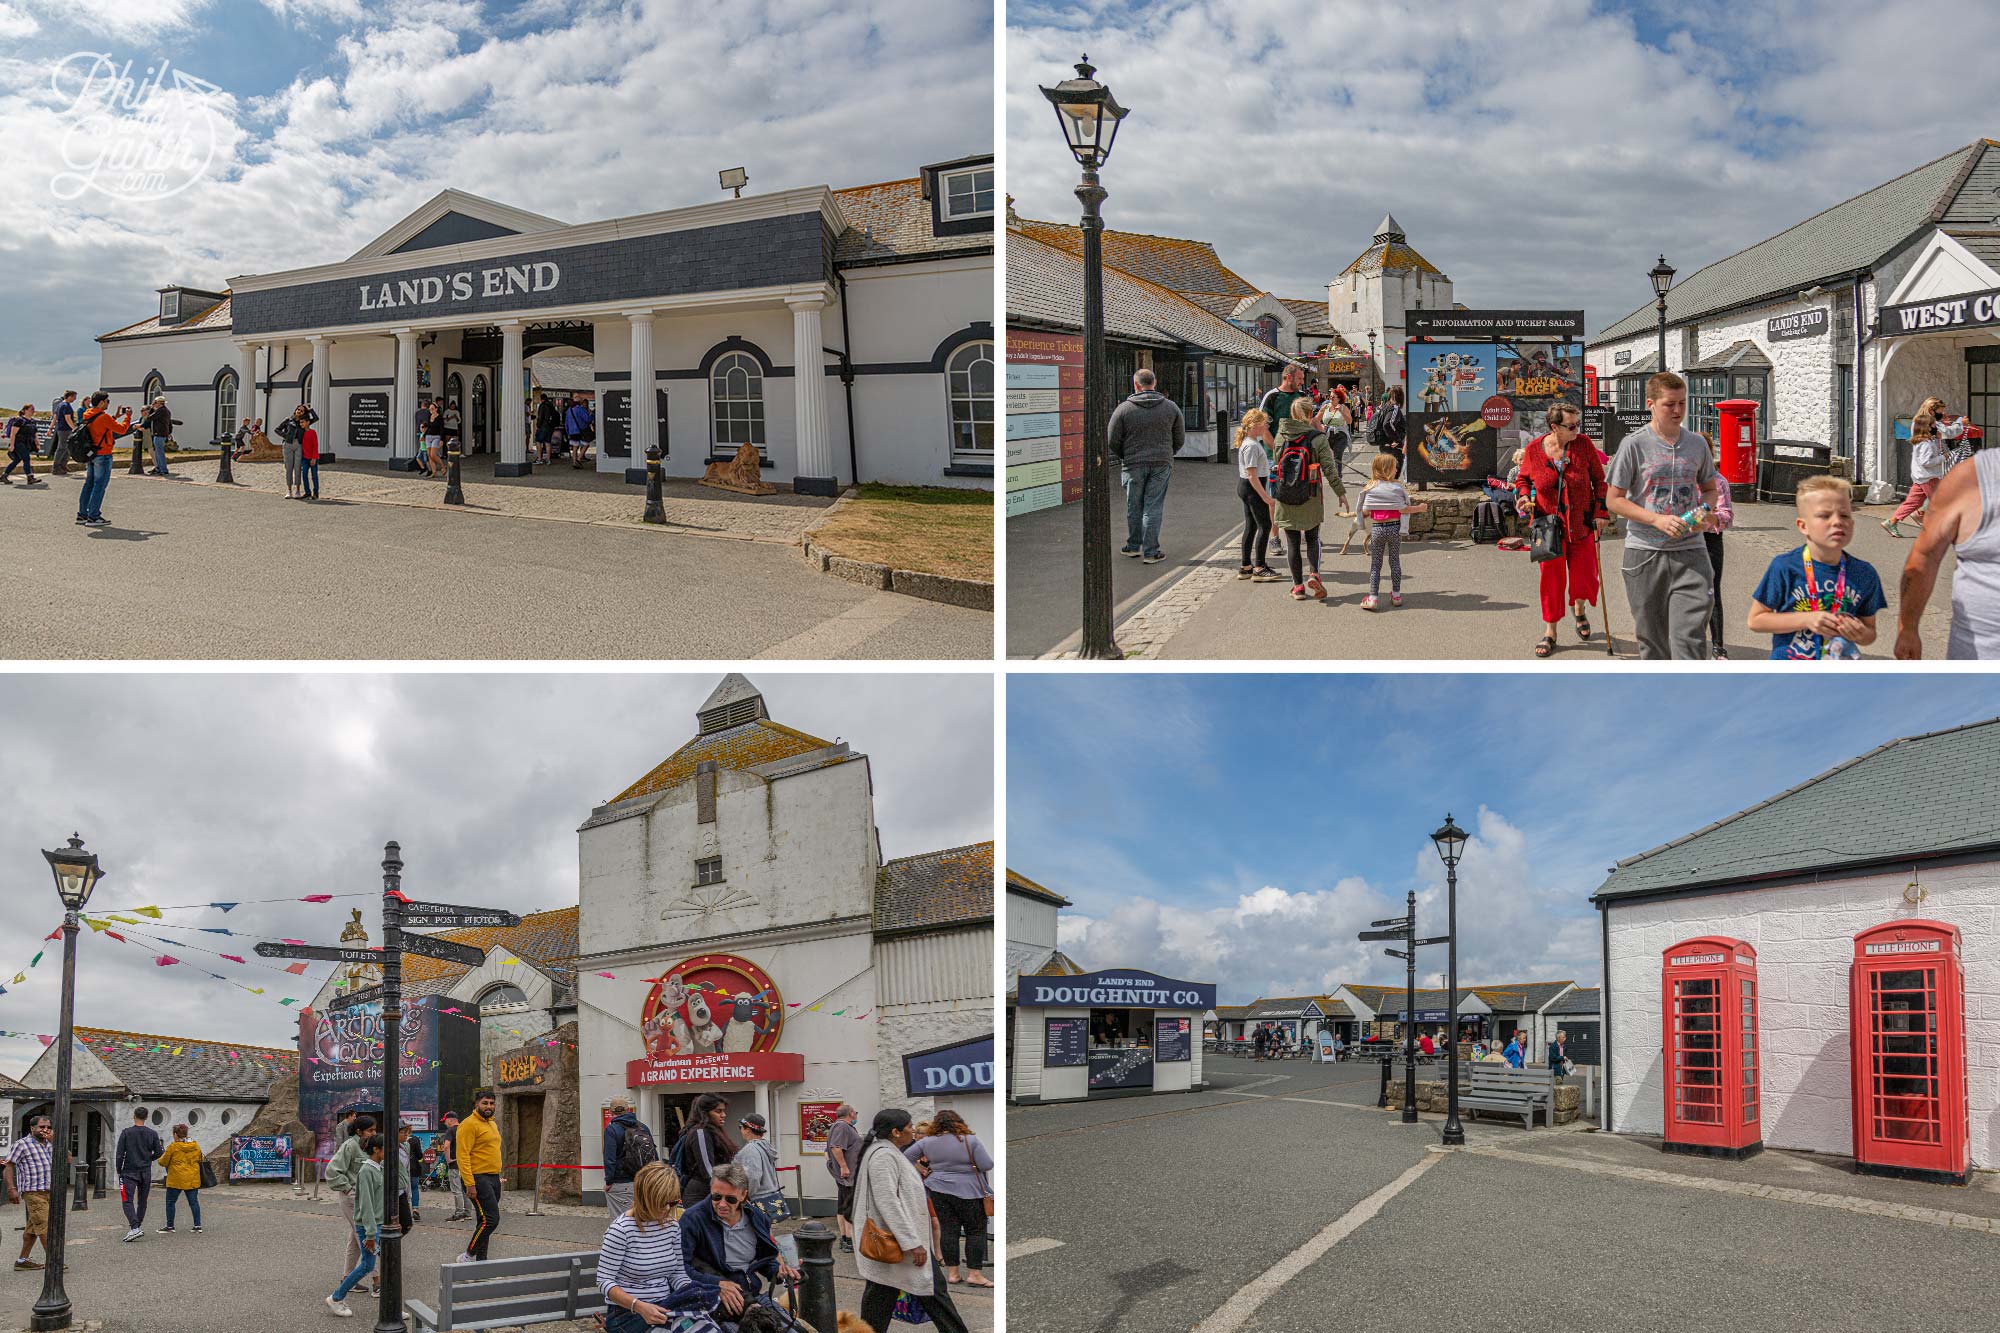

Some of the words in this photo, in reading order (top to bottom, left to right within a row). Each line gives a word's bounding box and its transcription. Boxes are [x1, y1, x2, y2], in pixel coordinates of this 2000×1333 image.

[359, 271, 473, 311] LAND'S
[481, 261, 560, 298] END
[1432, 319, 1494, 327] INFORMATION
[1495, 319, 1514, 327] AND
[1515, 319, 1547, 327] TICKET
[1548, 319, 1575, 327] SALES
[1769, 315, 1799, 332] LAND'S
[1800, 311, 1822, 327] END
[1899, 299, 1967, 330] WEST
[1006, 336, 1055, 352] Experience
[1055, 340, 1084, 353] Tickets
[1515, 378, 1558, 396] ROGER
[1525, 377, 1550, 385] JOLLY
[1012, 494, 1025, 504] End
[1791, 579, 1863, 607] WLCME
[407, 903, 455, 915] CAFETERIA
[408, 916, 429, 925] SIGN
[435, 916, 458, 925] POST
[464, 916, 502, 925] PHOTOS
[339, 950, 377, 960] TOILETS
[1871, 941, 1934, 953] TELEPHONE
[1675, 953, 1721, 965] TELEPHONE
[1098, 977, 1133, 986] LAND'S
[1135, 979, 1155, 987] END
[1035, 986, 1170, 1004] DOUGHNUT
[1172, 990, 1203, 1006] CO.
[499, 1055, 538, 1084] ROGER
[653, 1058, 692, 1068] Aardman
[696, 1054, 729, 1065] PRESENTS
[313, 1069, 364, 1083] Experience
[367, 1064, 382, 1079] the
[398, 1064, 422, 1080] gend
[641, 1071, 646, 1083] A
[647, 1069, 677, 1083] GRAND
[680, 1066, 755, 1081] EXPERIENCE
[923, 1061, 994, 1090] DOU
